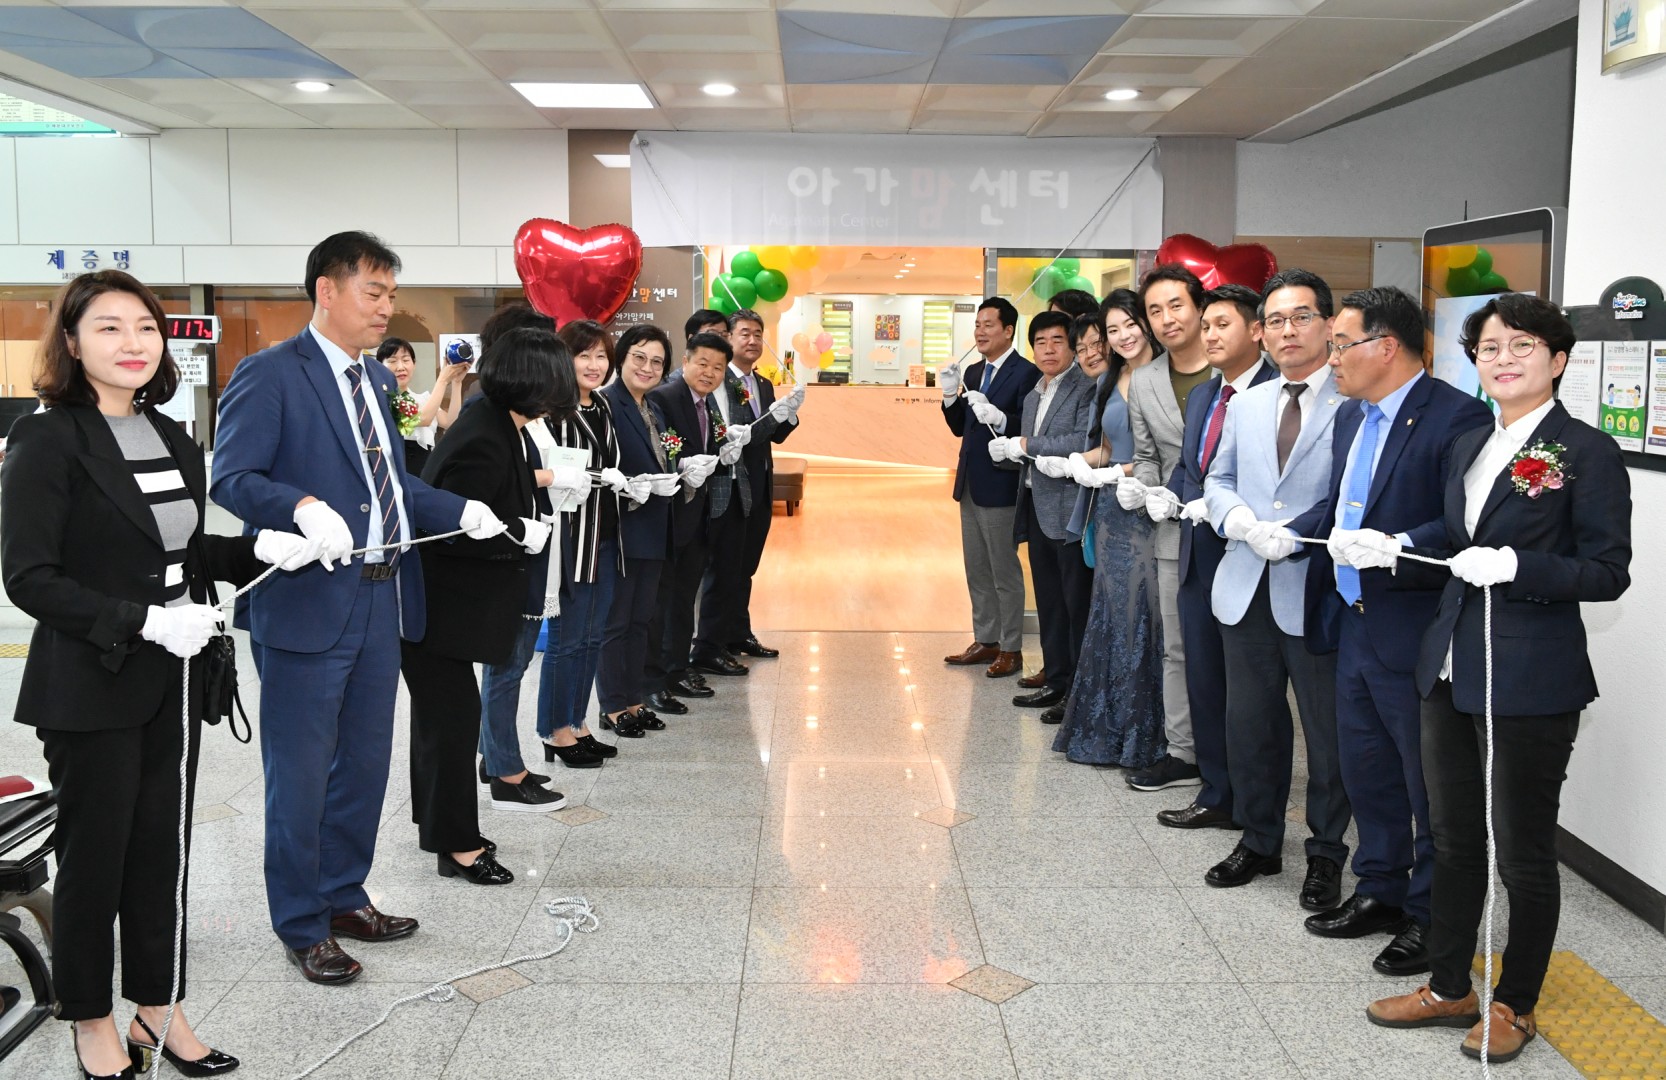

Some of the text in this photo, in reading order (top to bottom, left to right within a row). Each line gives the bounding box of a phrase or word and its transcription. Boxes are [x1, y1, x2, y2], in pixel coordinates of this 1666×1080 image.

[787, 166, 1069, 230] 아가맘센터
[840, 212, 890, 228] Center
[47, 249, 130, 270] 제증명
[615, 312, 654, 321] 아가맘카페
[173, 320, 204, 337] 117
